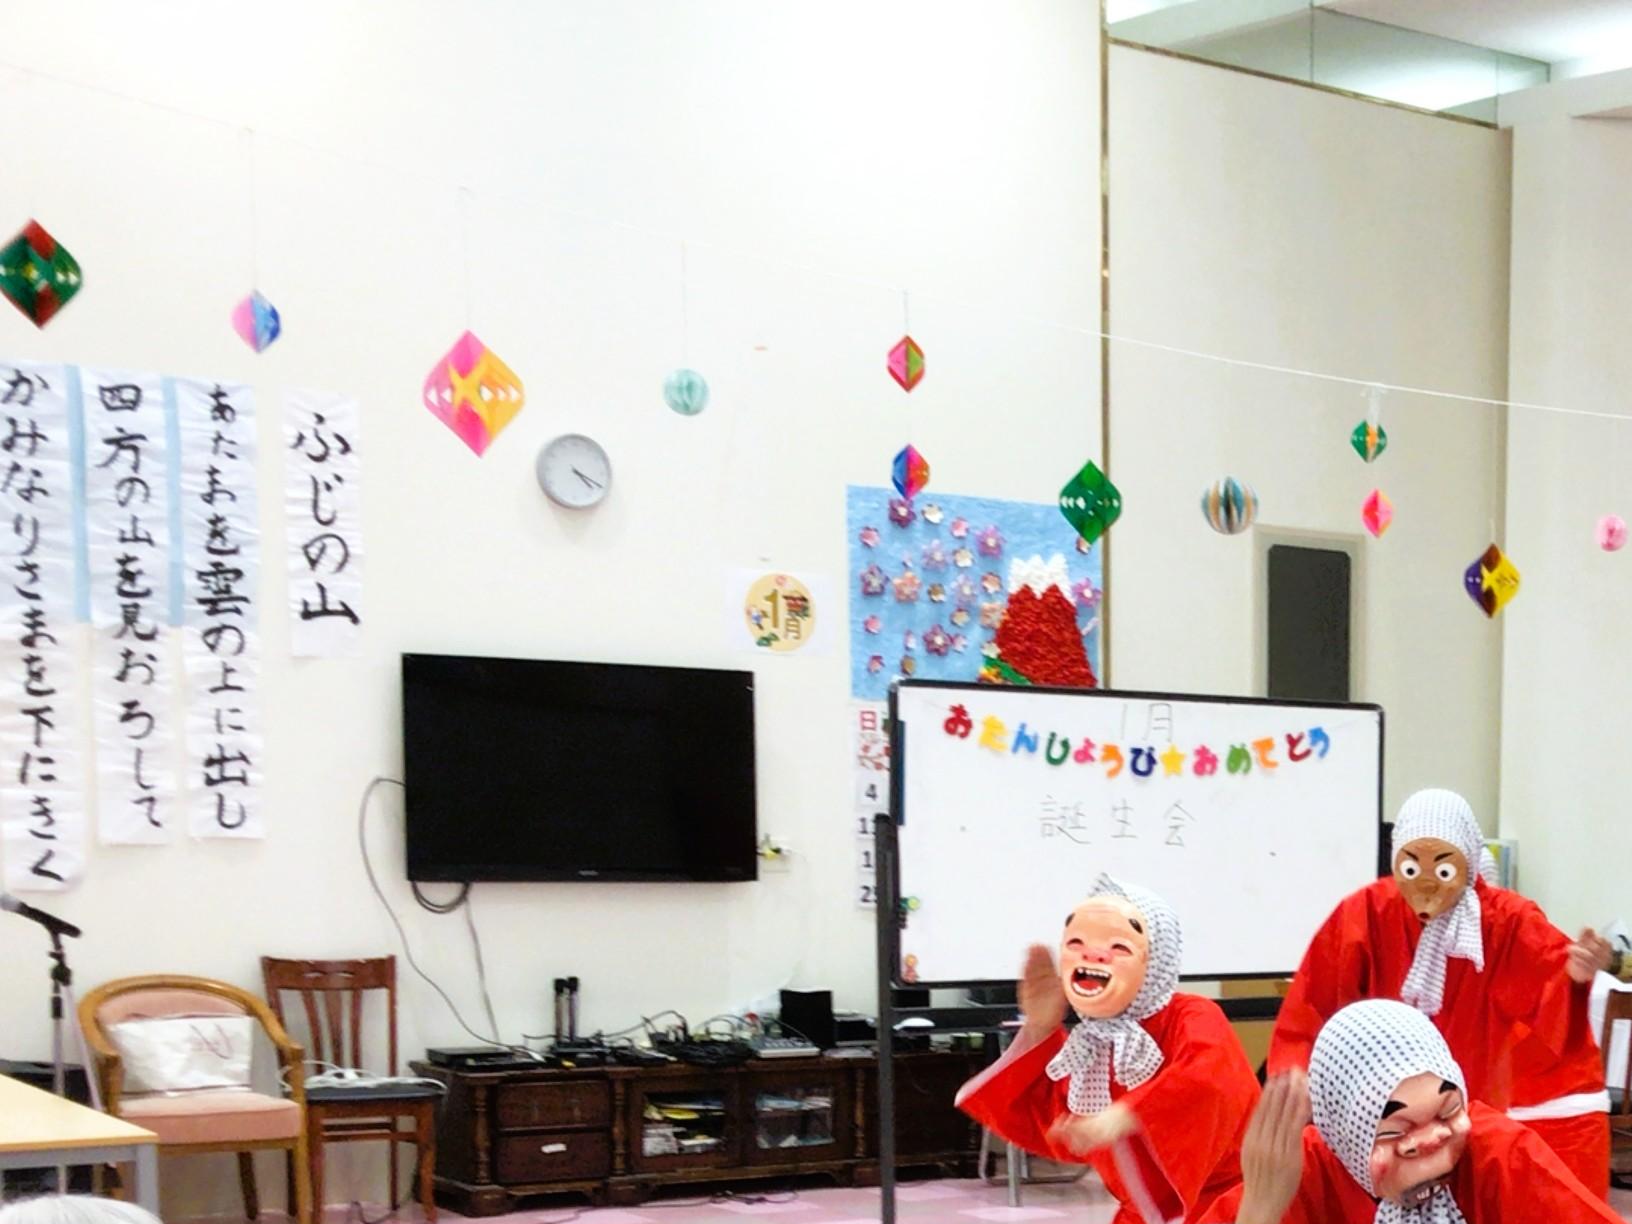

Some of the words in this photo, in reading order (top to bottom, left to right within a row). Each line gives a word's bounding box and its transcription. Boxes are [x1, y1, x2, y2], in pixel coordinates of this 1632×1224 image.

[0, 367, 64, 882] かみなりさまを下にきく
[94, 384, 163, 828] 四方の山を見おろして
[195, 384, 251, 829] あたまを雲の上に出し
[289, 411, 360, 625] ふじの山
[860, 710, 877, 731] 日
[865, 783, 878, 801] 4
[1038, 794, 1198, 847] 誕生会
